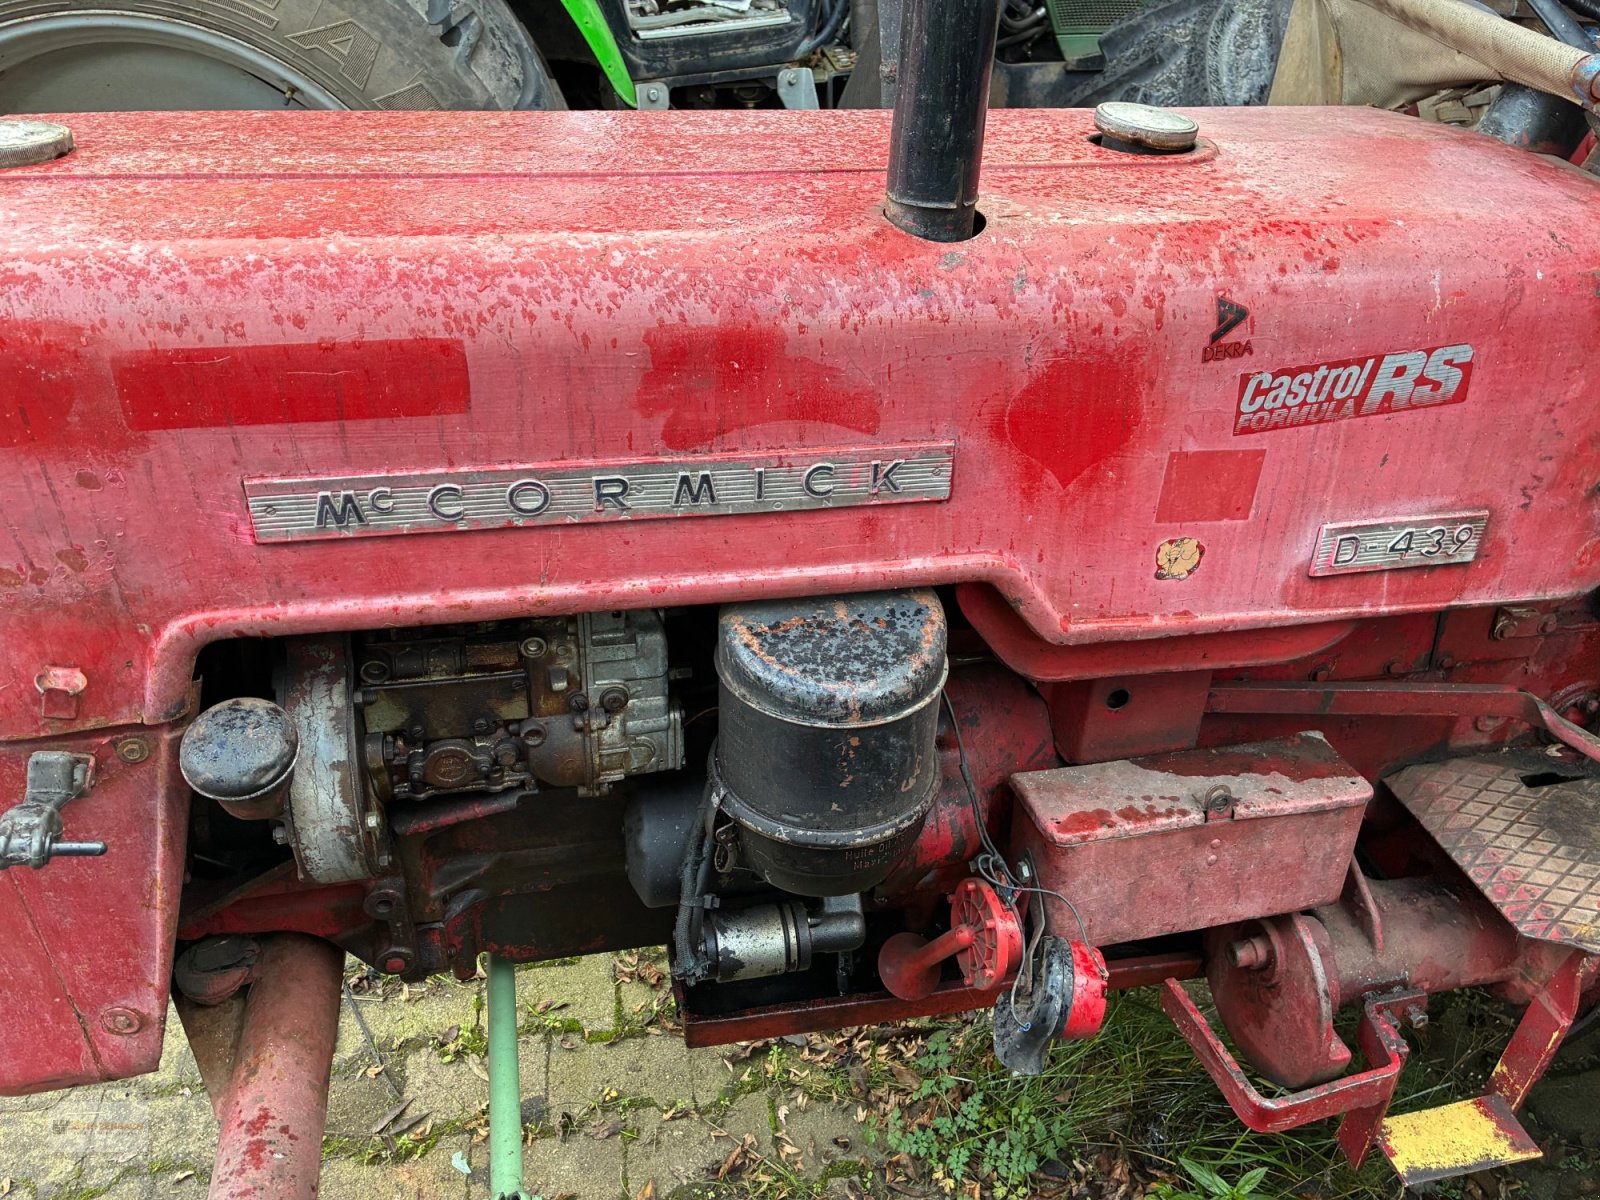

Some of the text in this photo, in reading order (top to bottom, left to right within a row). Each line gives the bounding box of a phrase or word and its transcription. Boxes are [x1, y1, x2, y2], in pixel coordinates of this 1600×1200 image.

[1202, 339, 1254, 363] DEKRA
[1240, 344, 1474, 415] Castrol RS
[1234, 399, 1355, 433] FORMULA
